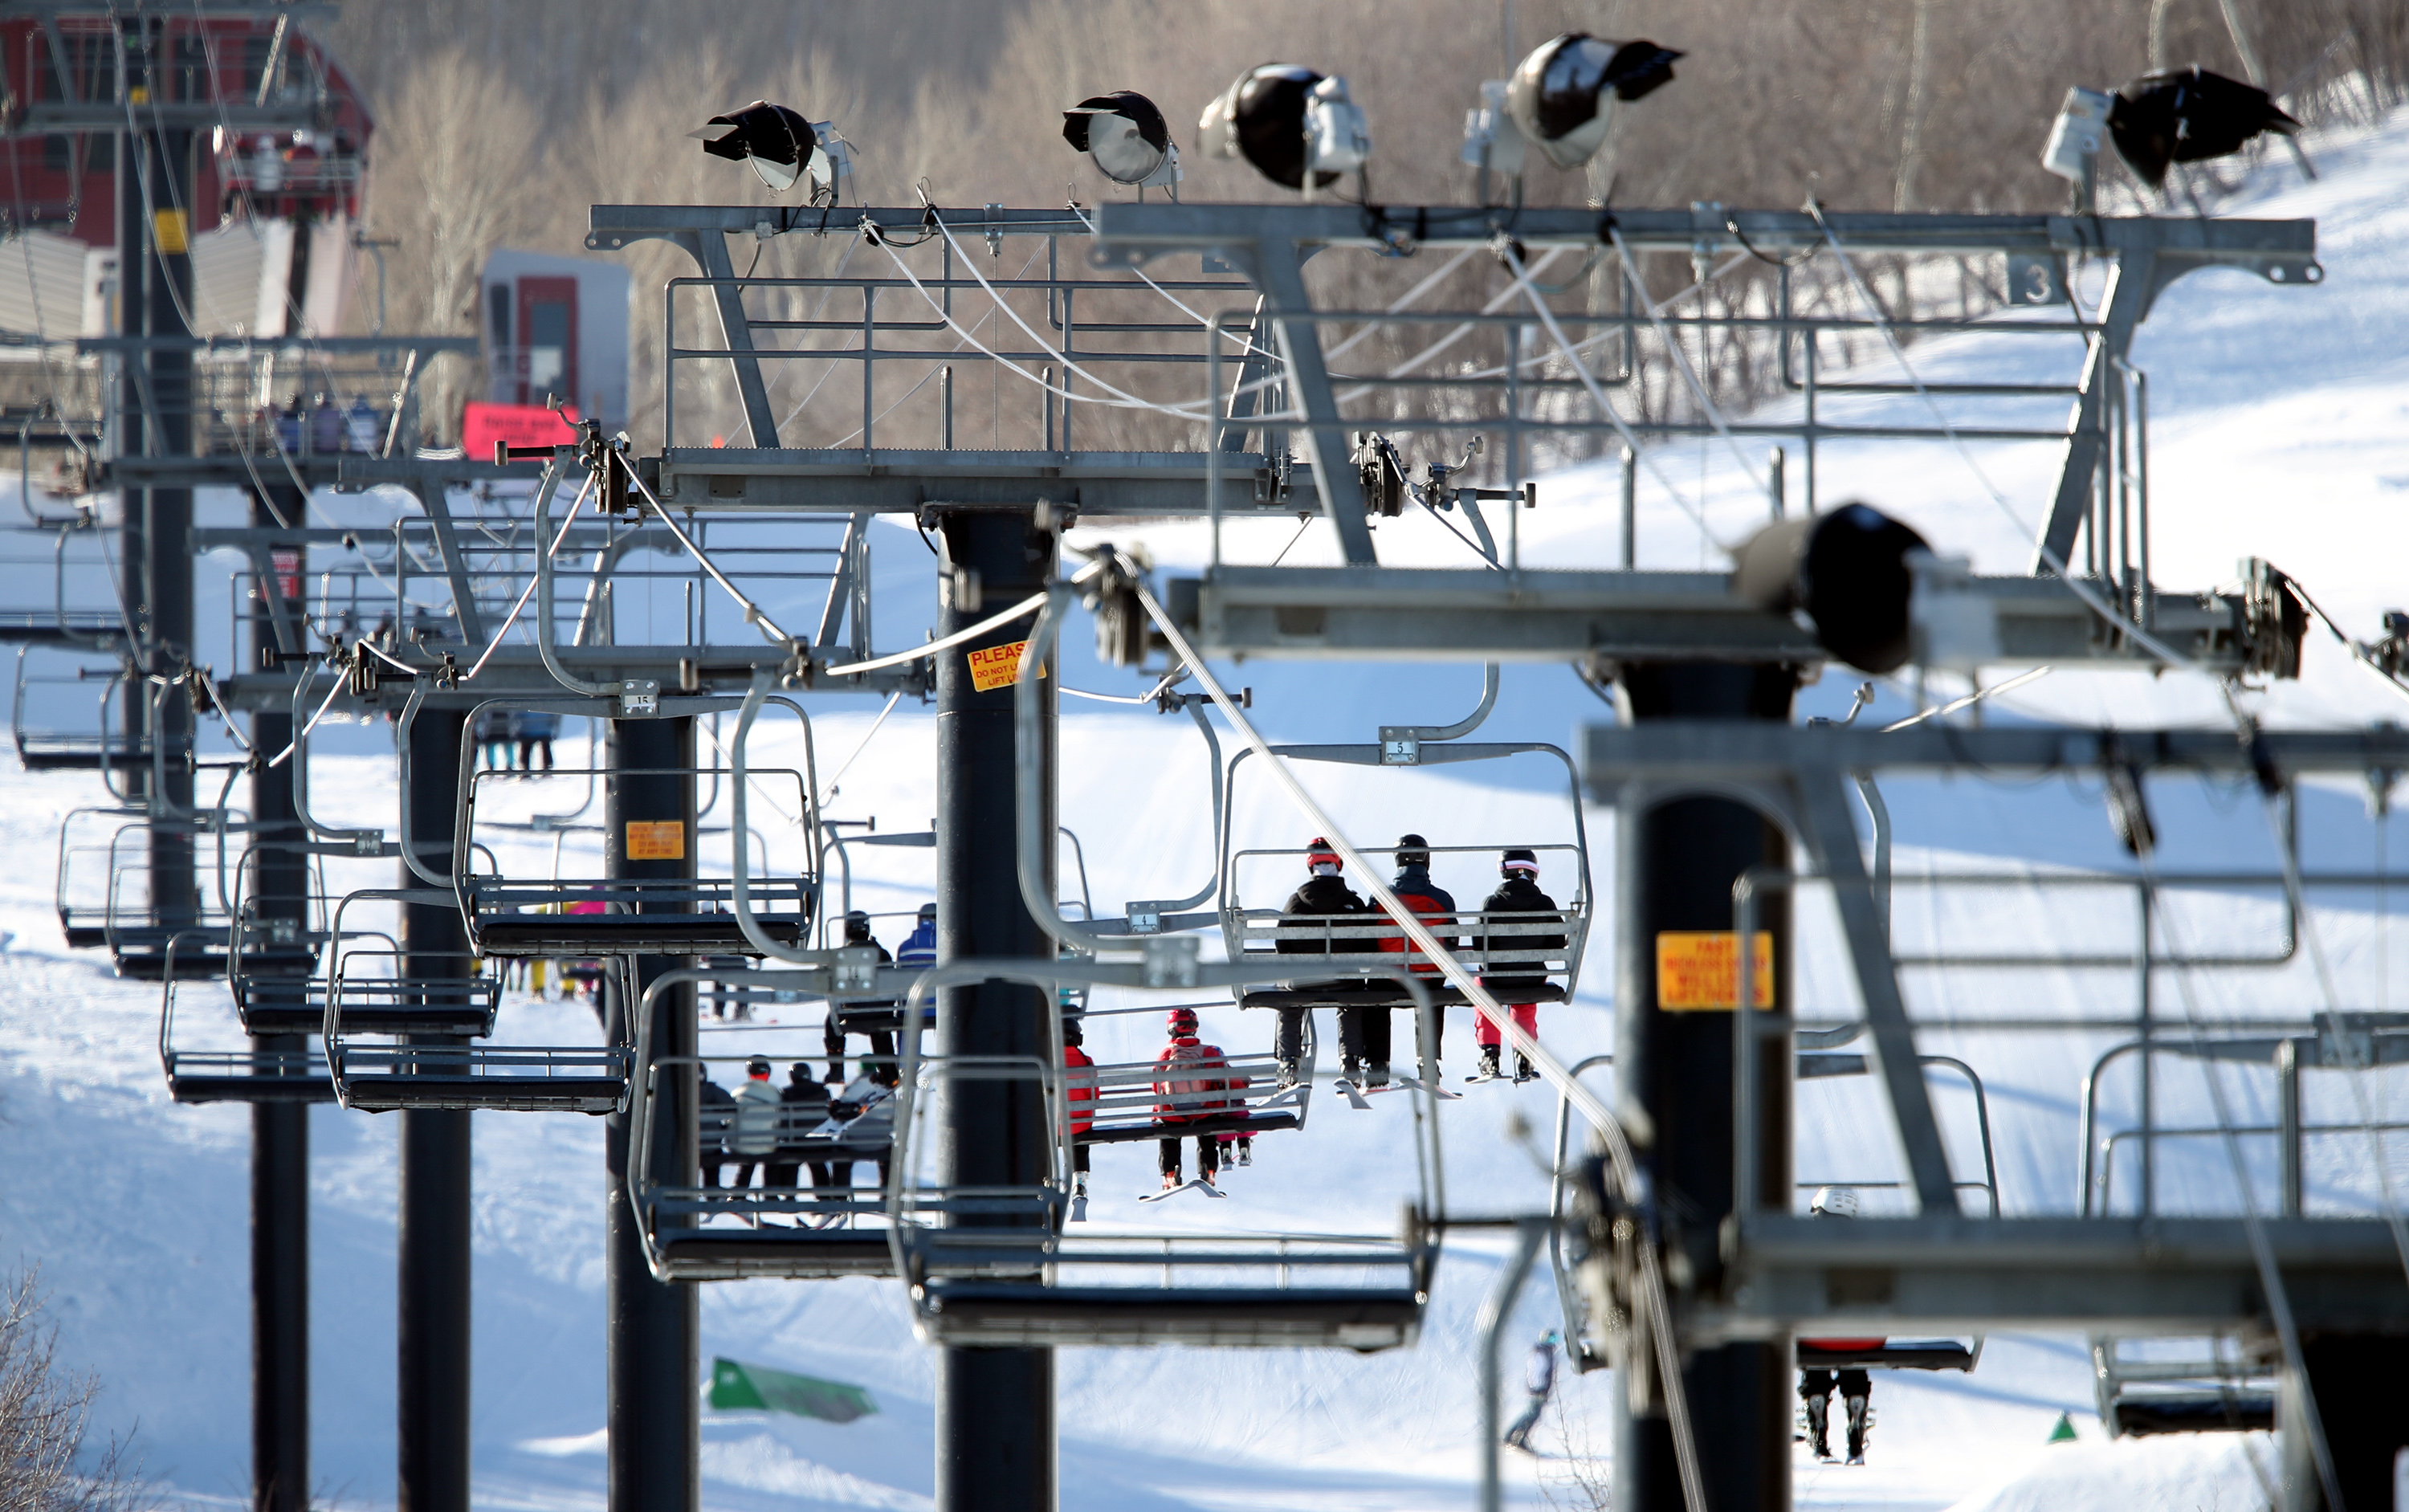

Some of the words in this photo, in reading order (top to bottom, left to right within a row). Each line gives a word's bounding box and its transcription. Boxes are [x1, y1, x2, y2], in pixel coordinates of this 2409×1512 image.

[2024, 264, 2052, 304] 3
[972, 642, 1028, 666] PLEAS
[976, 670, 988, 679] DO
[990, 665, 1007, 674] NOT
[987, 676, 1005, 686] LIFT
[637, 696, 648, 705] 15
[1397, 742, 1404, 754] 5
[1141, 915, 1147, 925] 4
